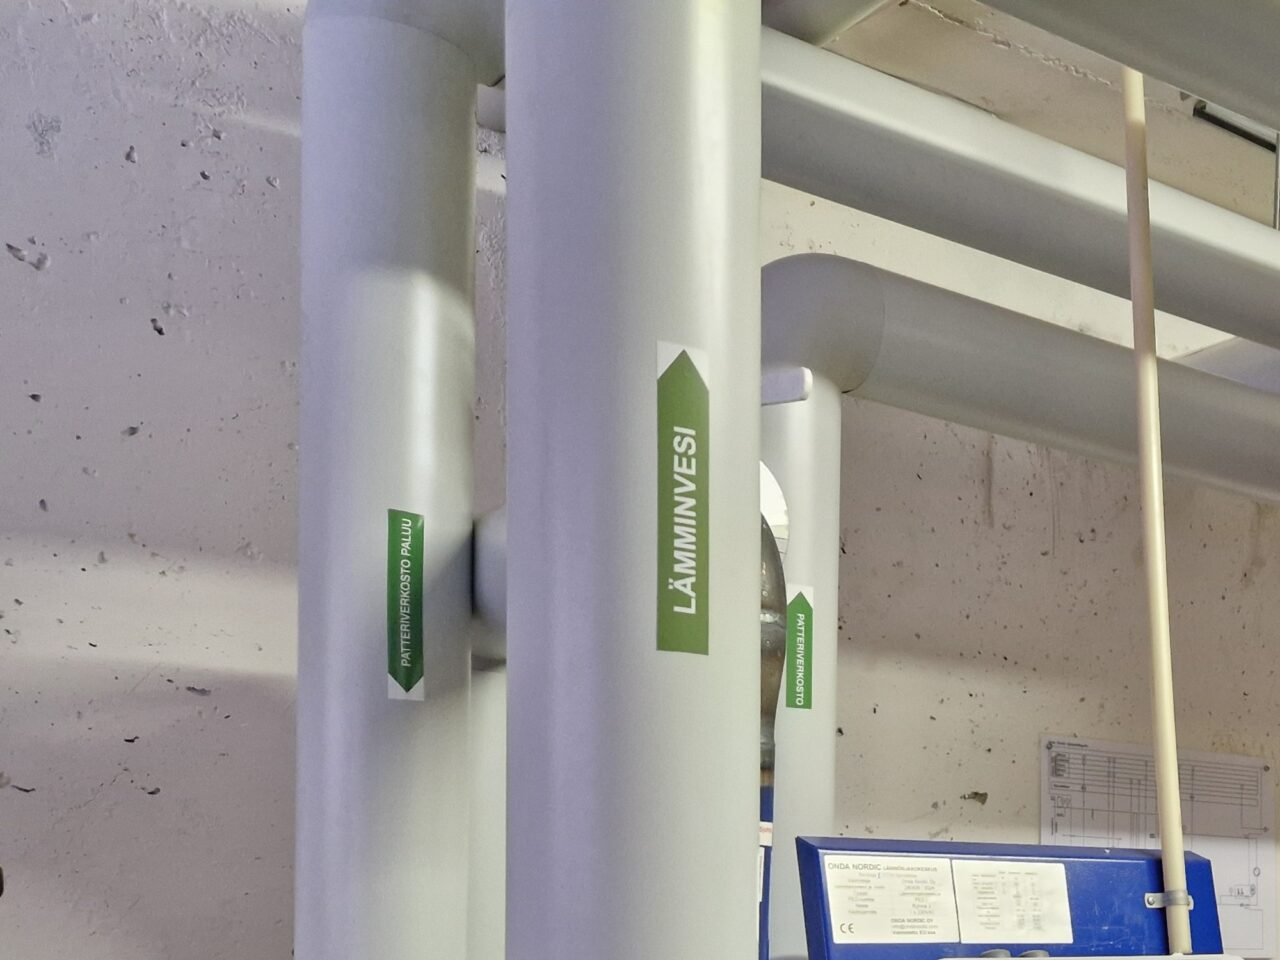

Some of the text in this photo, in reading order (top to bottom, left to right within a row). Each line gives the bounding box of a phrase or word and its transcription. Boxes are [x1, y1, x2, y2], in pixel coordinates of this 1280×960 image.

[668, 426, 697, 614] LÄMMINVESI
[400, 518, 413, 667] PATTERIVERKOSTO PALUU
[795, 613, 805, 706] PATTERIVERKOSTO
[852, 863, 882, 871] NORDIC
